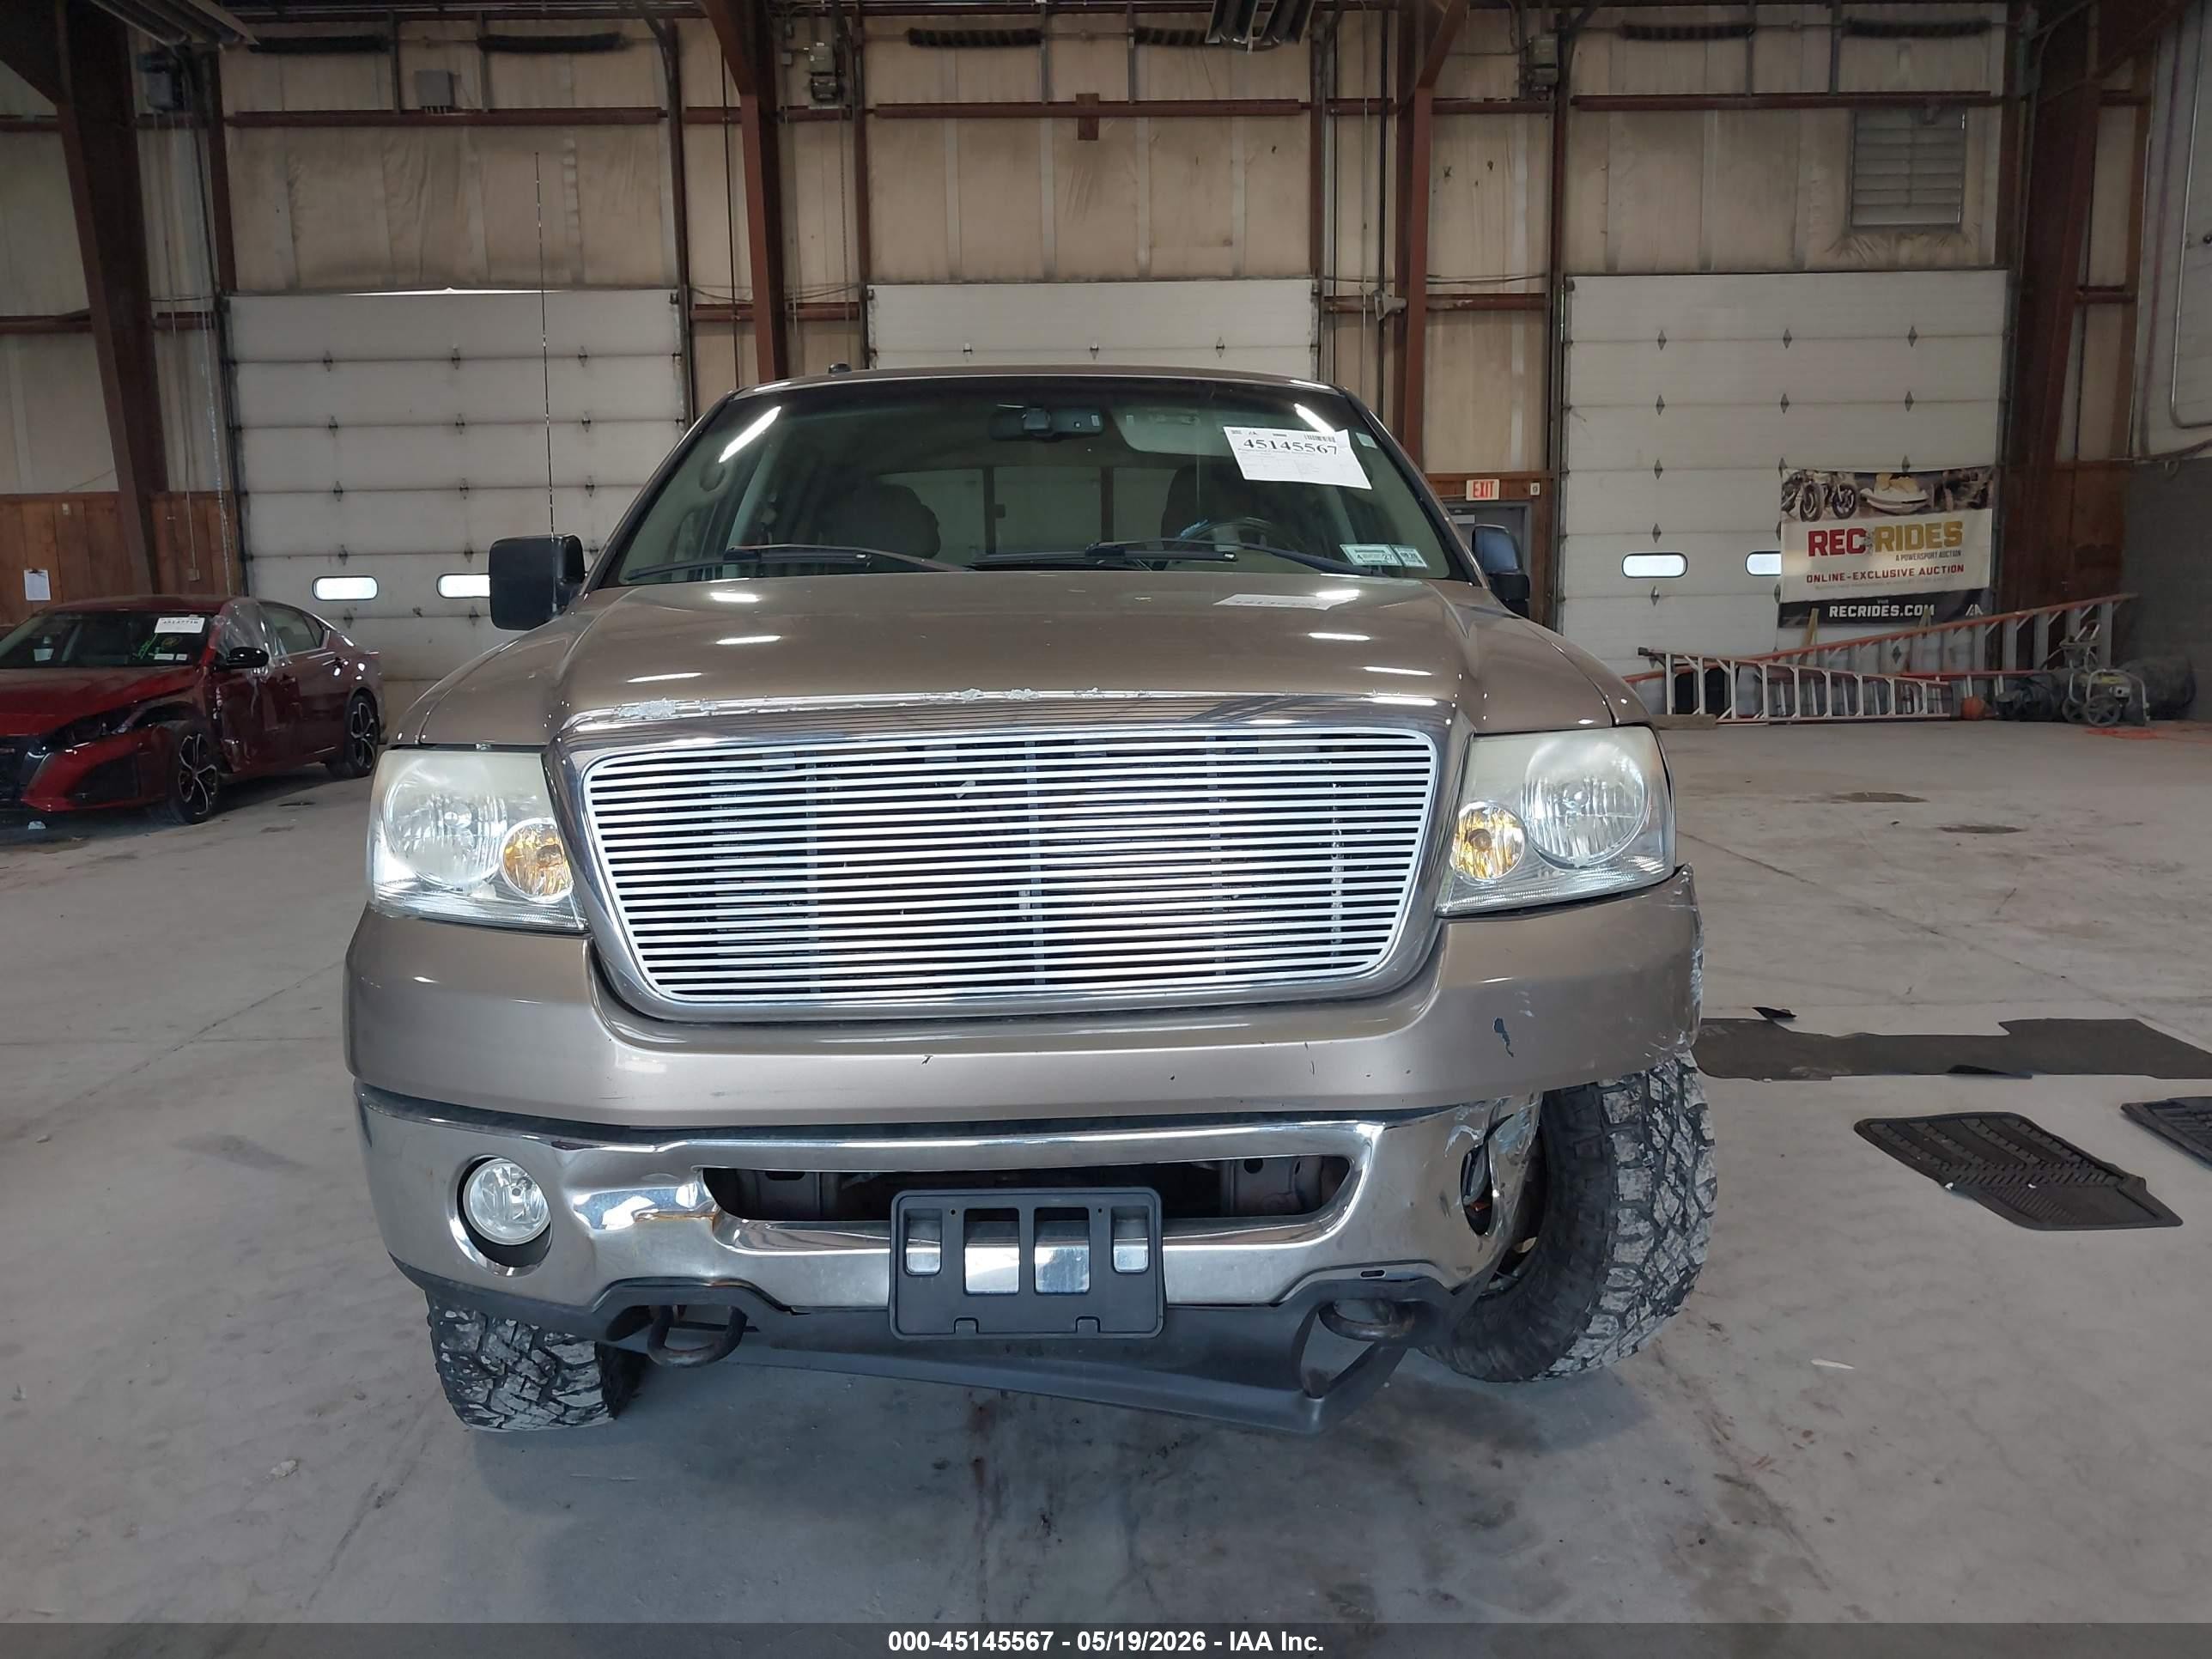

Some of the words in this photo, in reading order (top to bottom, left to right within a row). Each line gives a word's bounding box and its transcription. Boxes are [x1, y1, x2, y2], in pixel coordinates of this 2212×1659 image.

[1243, 439, 1337, 455] 45145567
[1473, 480, 1494, 498] EXIT
[1808, 527, 1867, 557] REC
[1874, 520, 1964, 553] RIDES
[1900, 551, 1938, 562] POWERSPORT
[1939, 549, 1962, 558] AUCTION
[1806, 568, 1915, 584] ONLINE-EXCLUSIVE
[1918, 564, 1965, 576] AUCTION
[1828, 604, 1935, 618] RECRIDES.COM
